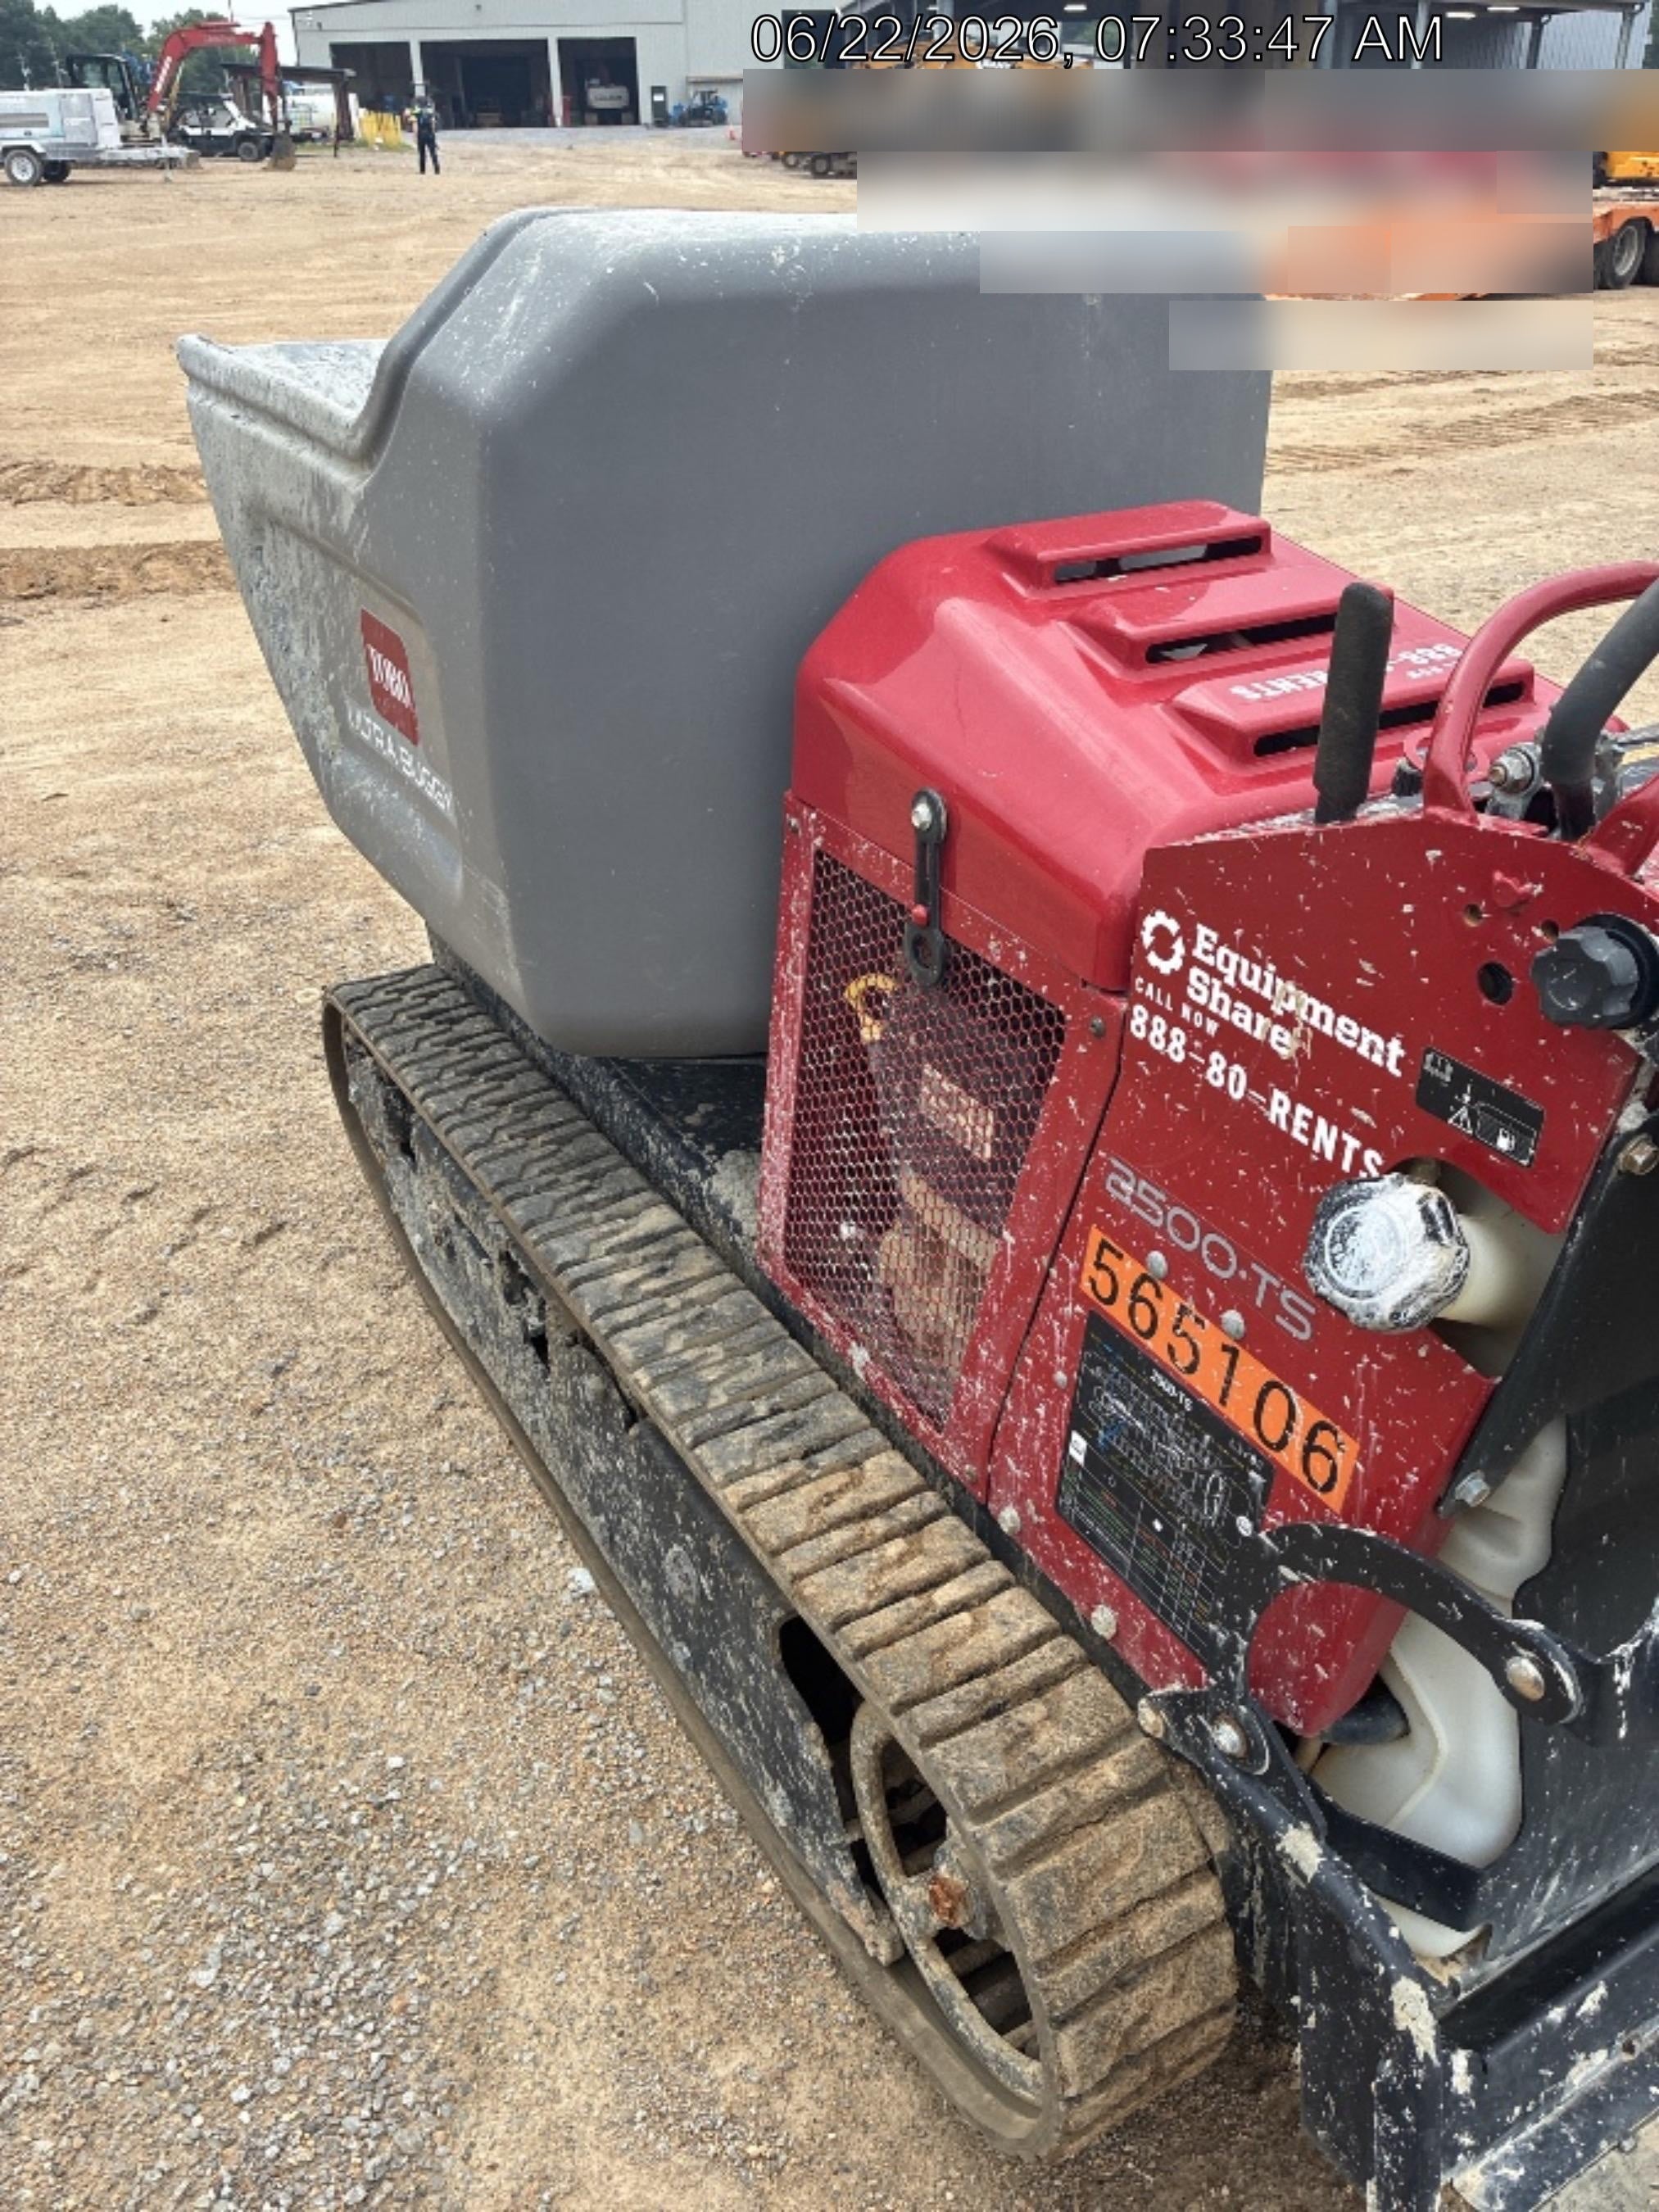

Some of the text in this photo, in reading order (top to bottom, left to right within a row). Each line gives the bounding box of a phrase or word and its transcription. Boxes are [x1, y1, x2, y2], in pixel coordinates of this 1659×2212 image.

[1134, 976, 1220, 1038] CALL NOW
[1187, 965, 1297, 1060] Share
[1192, 922, 1406, 1077] Equipment
[1130, 1004, 1384, 1178] 888-80-RENTS
[1088, 1238, 1346, 1494] 565106
